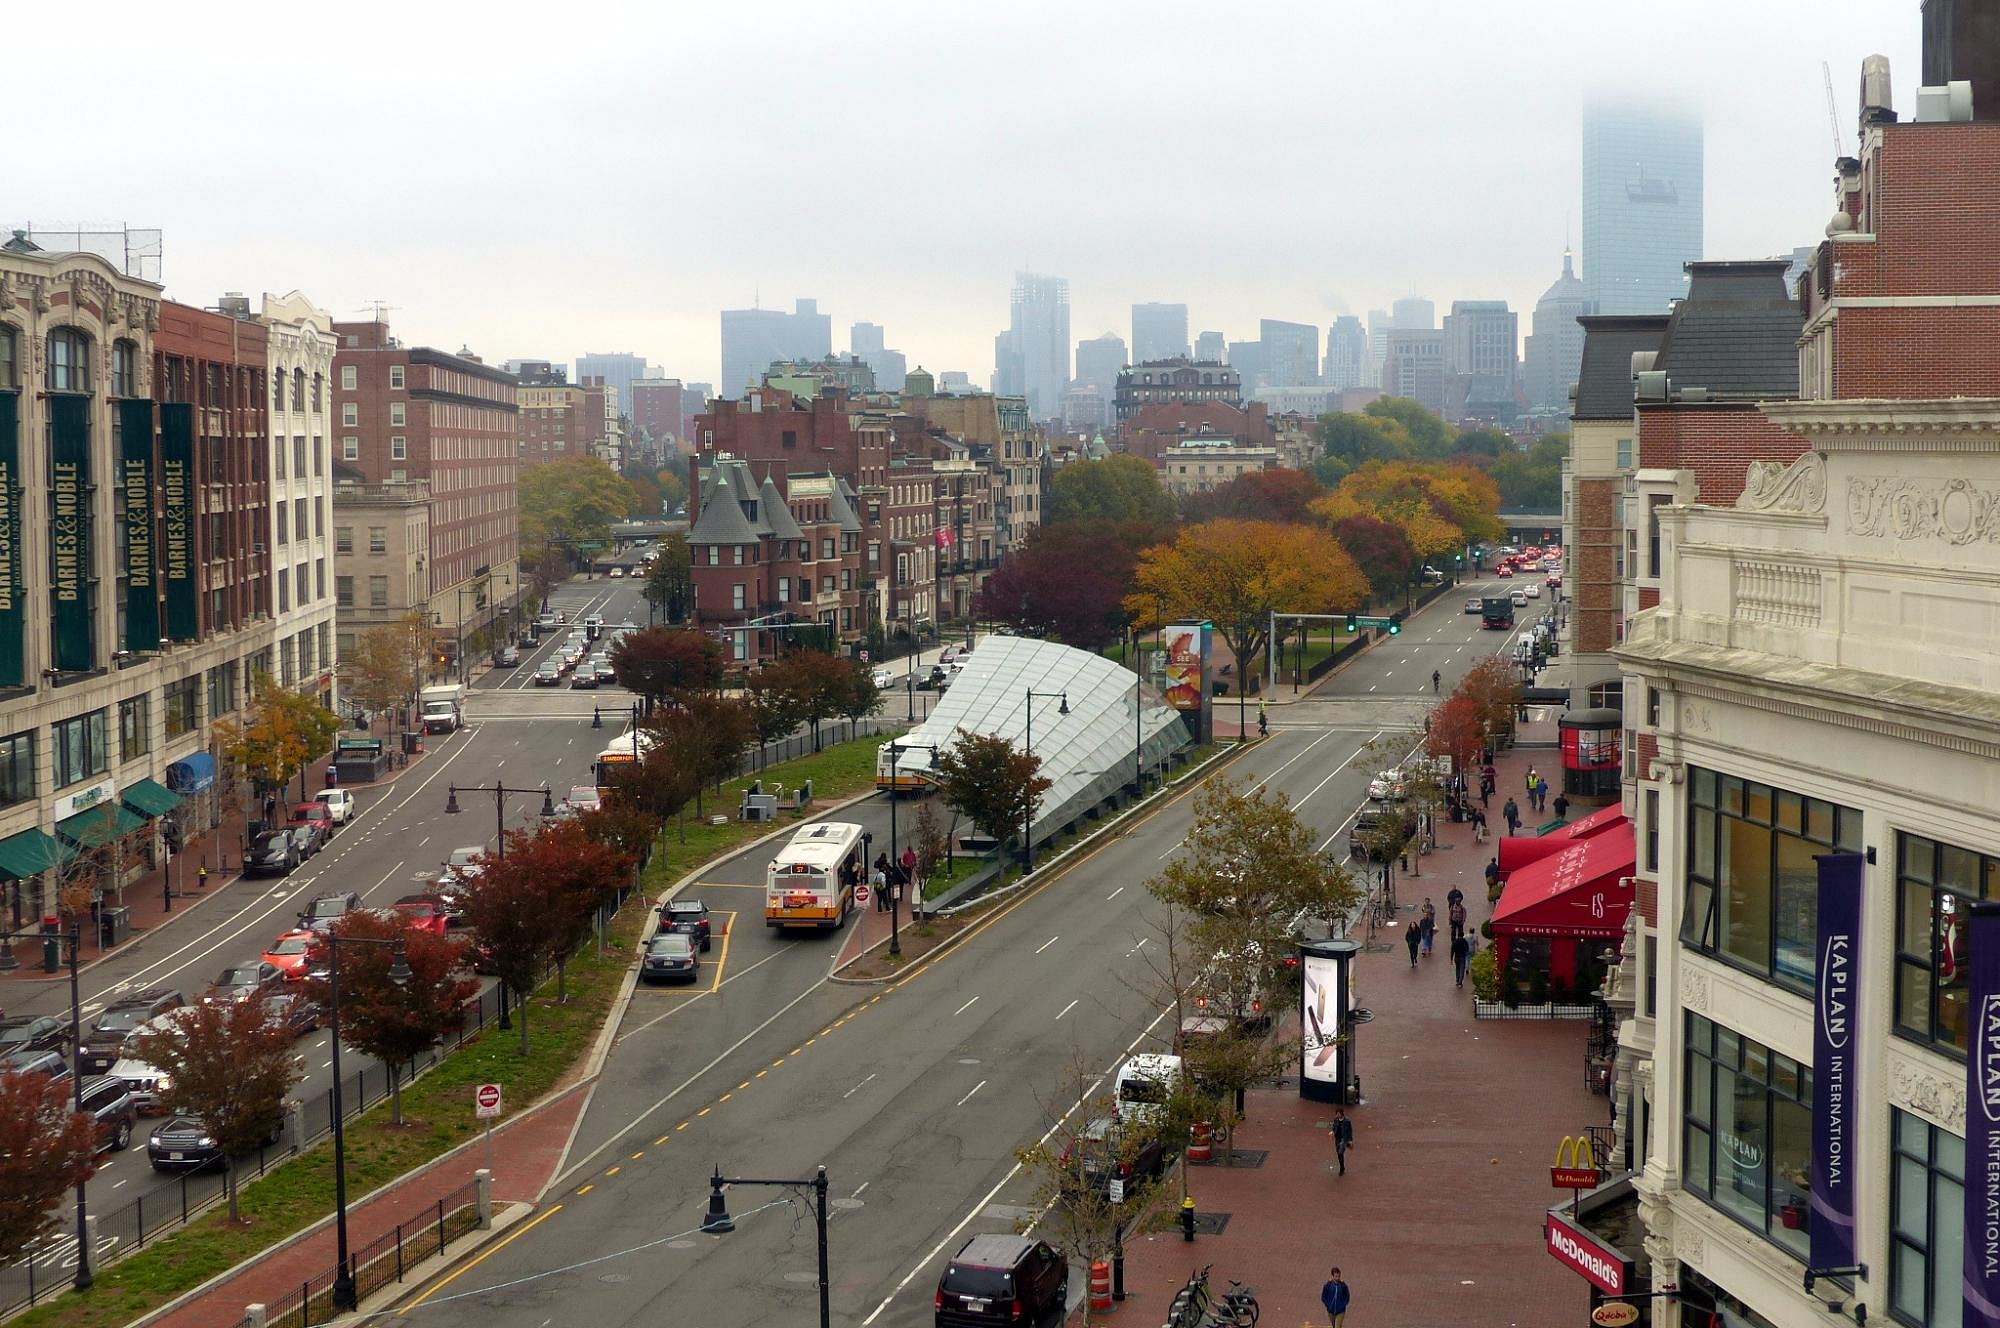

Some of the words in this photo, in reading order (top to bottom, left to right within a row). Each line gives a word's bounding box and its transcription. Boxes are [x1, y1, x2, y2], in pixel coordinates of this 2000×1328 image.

[55, 462, 77, 516] NOBLE
[126, 459, 147, 508] NOBLE
[165, 459, 185, 506] NOBLE
[55, 516, 78, 535] &
[128, 508, 148, 527] &
[167, 506, 186, 522] &
[57, 535, 78, 601] BARNES
[129, 527, 149, 587] BARNES
[168, 522, 187, 579] BARNES
[1592, 892, 1604, 919] ES
[1514, 926, 1559, 934] KITCHEN
[1573, 928, 1611, 937] DRINKS
[1830, 935, 1848, 1034] KAPLAN
[1986, 994, 2000, 1105] KAPLAN
[1721, 1129, 1758, 1161] KAPLAN
[1829, 1055, 1843, 1189] INTERNATIONAL
[1985, 1129, 2000, 1279] INTERNATIONAL
[1551, 1228, 1619, 1289] McDonald's
[1595, 1309, 1627, 1321] Qdoba
